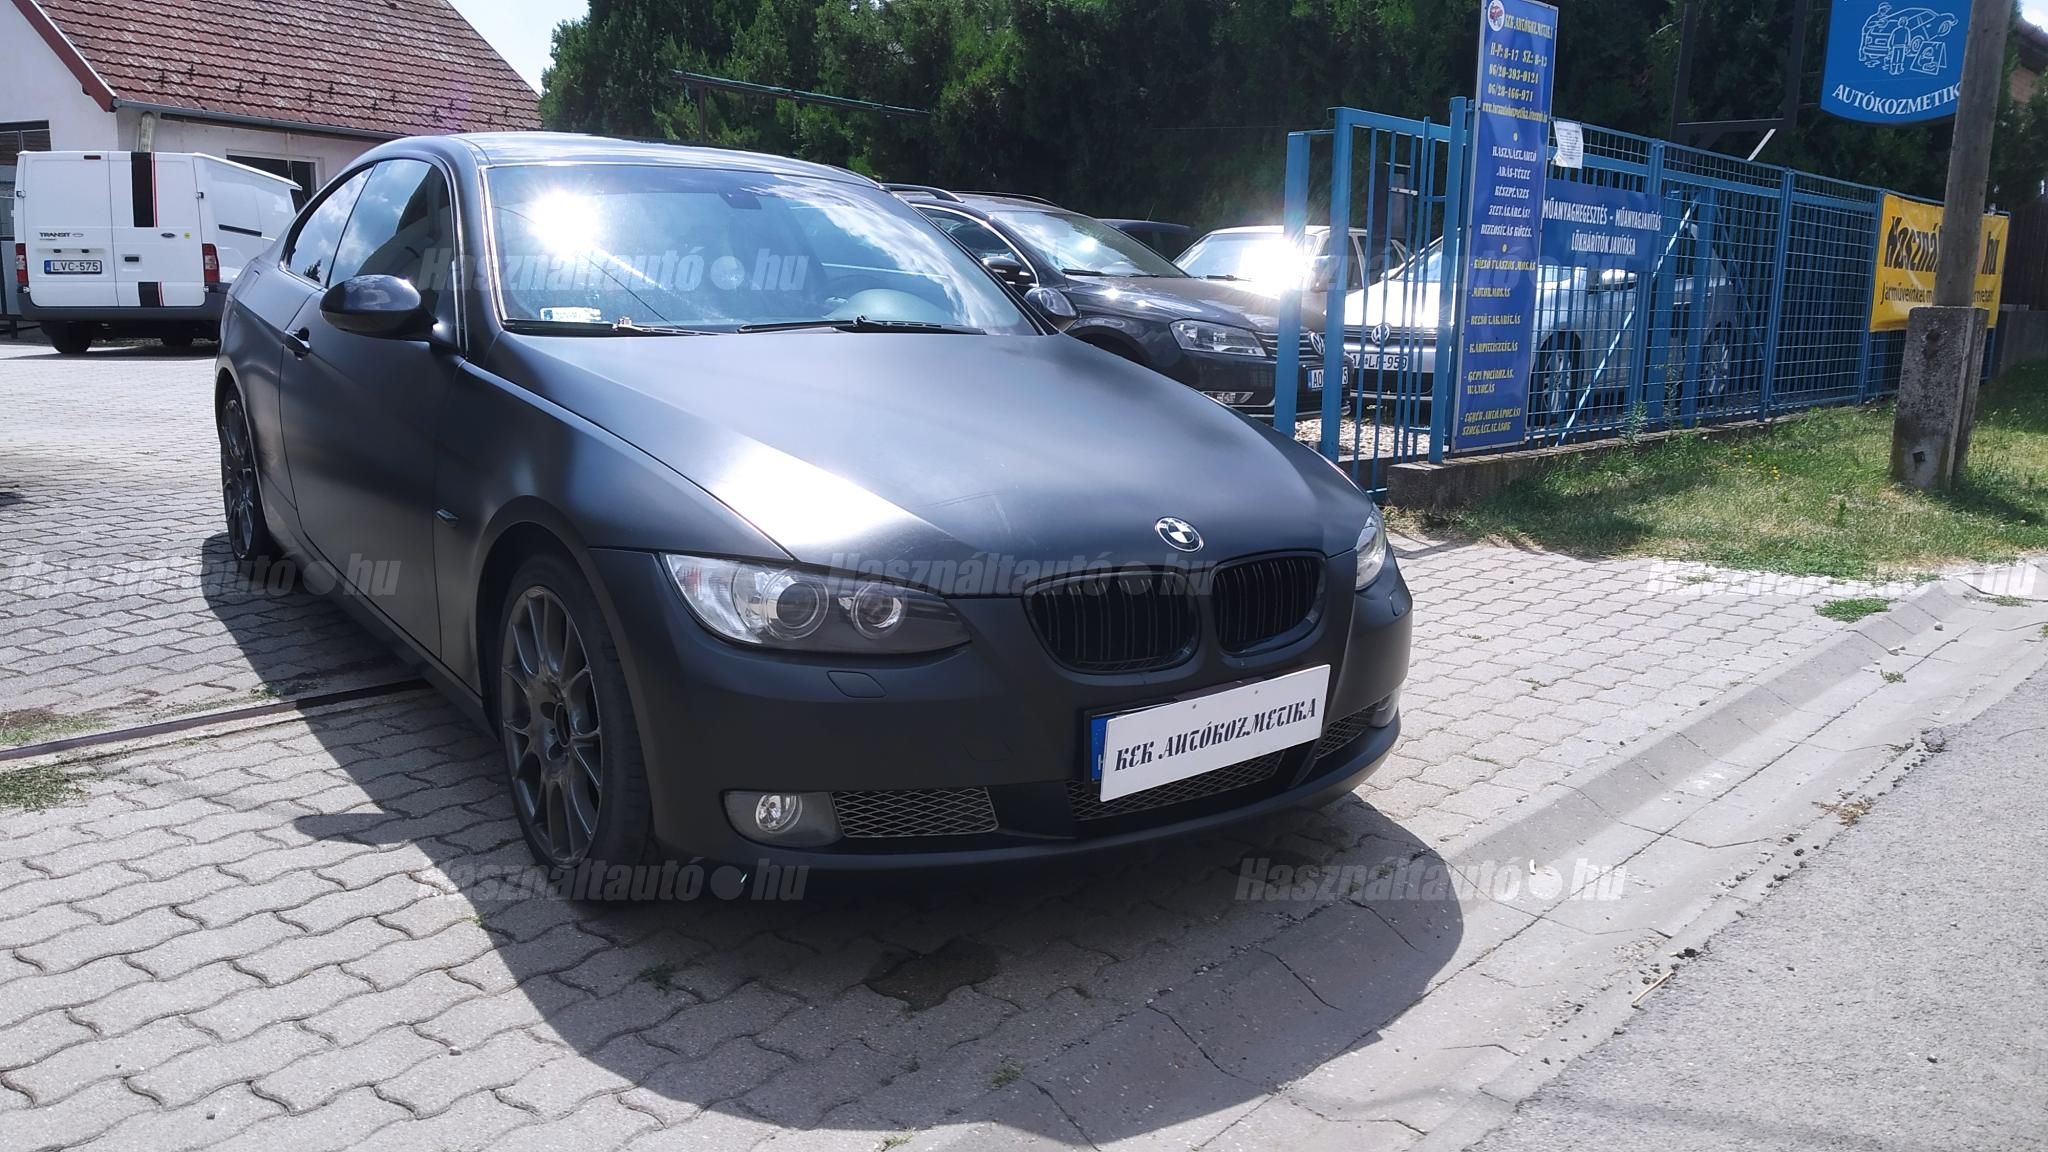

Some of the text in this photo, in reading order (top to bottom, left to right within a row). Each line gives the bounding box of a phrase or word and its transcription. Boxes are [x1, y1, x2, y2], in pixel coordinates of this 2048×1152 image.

[1832, 81, 1960, 114] AUTÓKOZMETIK
[1542, 197, 1608, 225] MŰANYAGHEGESZTÉS
[52, 262, 99, 271] LVC-575
[1114, 698, 1317, 771] KEK AUTÓKOZMETIKA
